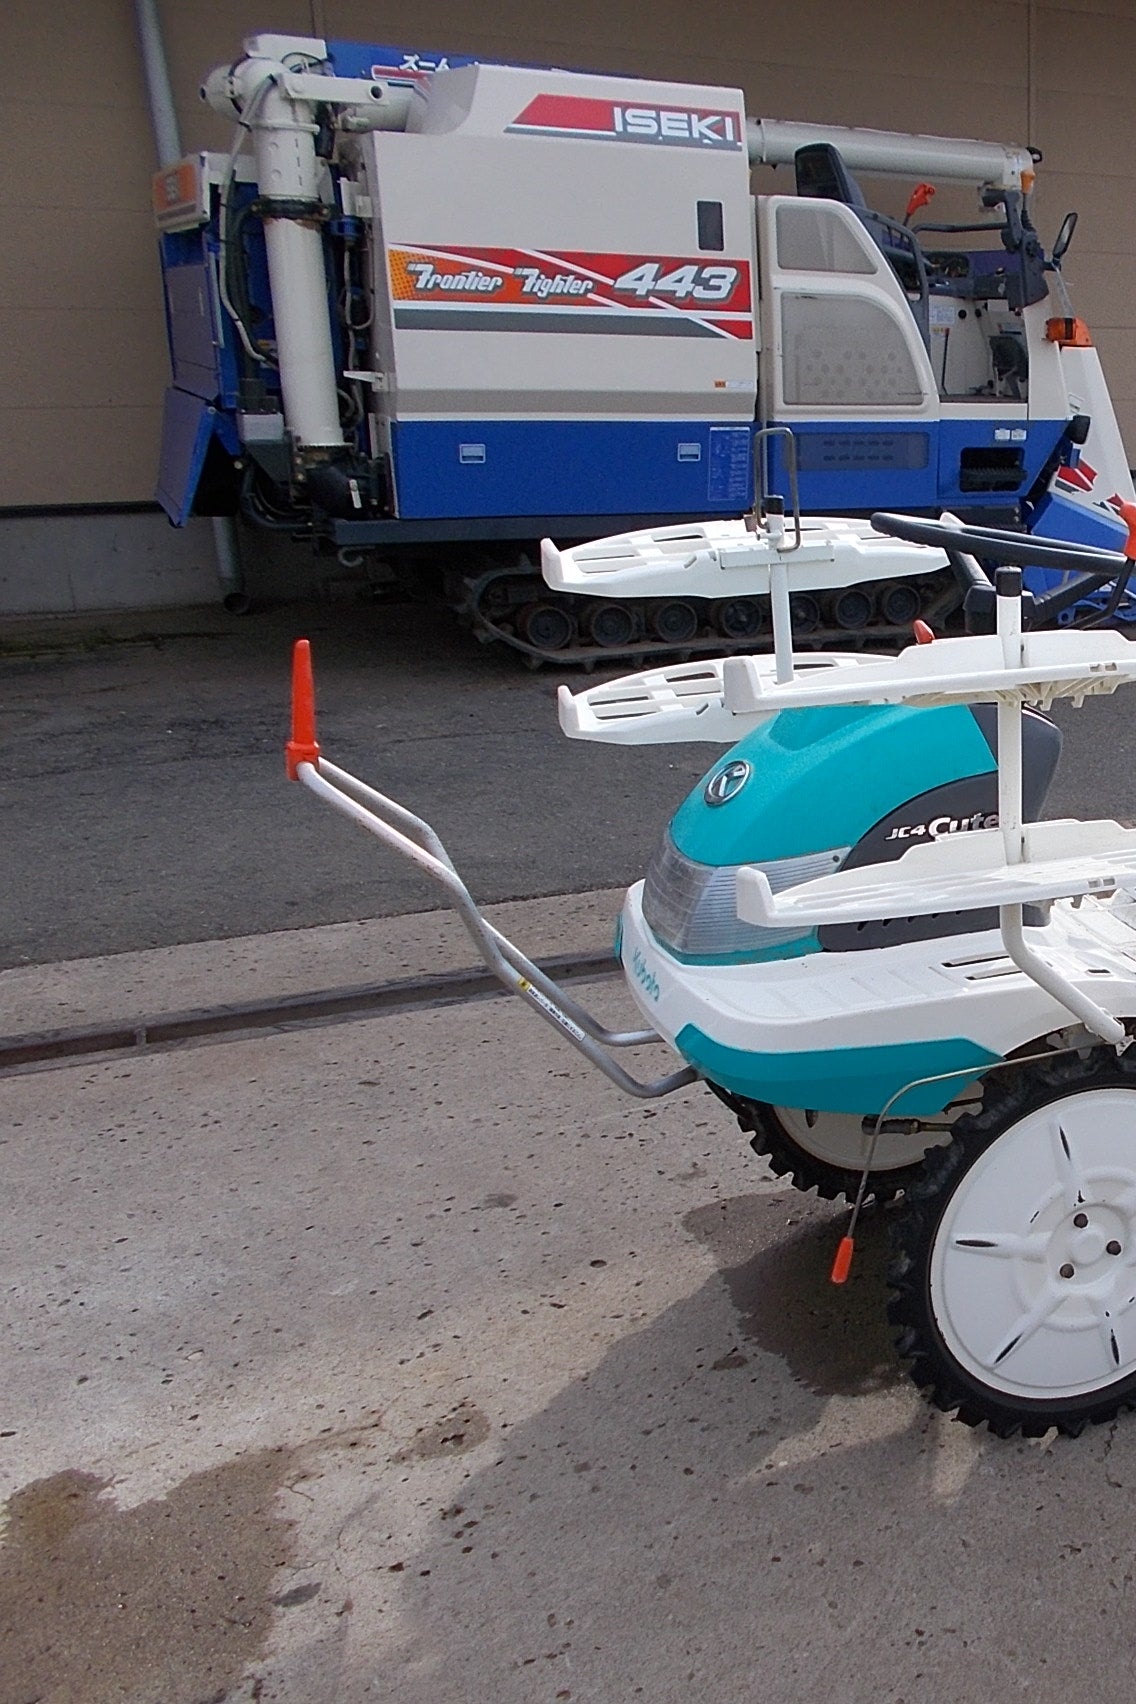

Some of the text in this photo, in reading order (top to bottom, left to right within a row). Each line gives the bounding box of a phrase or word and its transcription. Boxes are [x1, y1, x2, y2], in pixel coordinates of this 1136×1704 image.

[614, 107, 734, 142] ISEKI
[406, 262, 738, 301] Frontier Fighter 443
[885, 812, 999, 841] JC4 Cute
